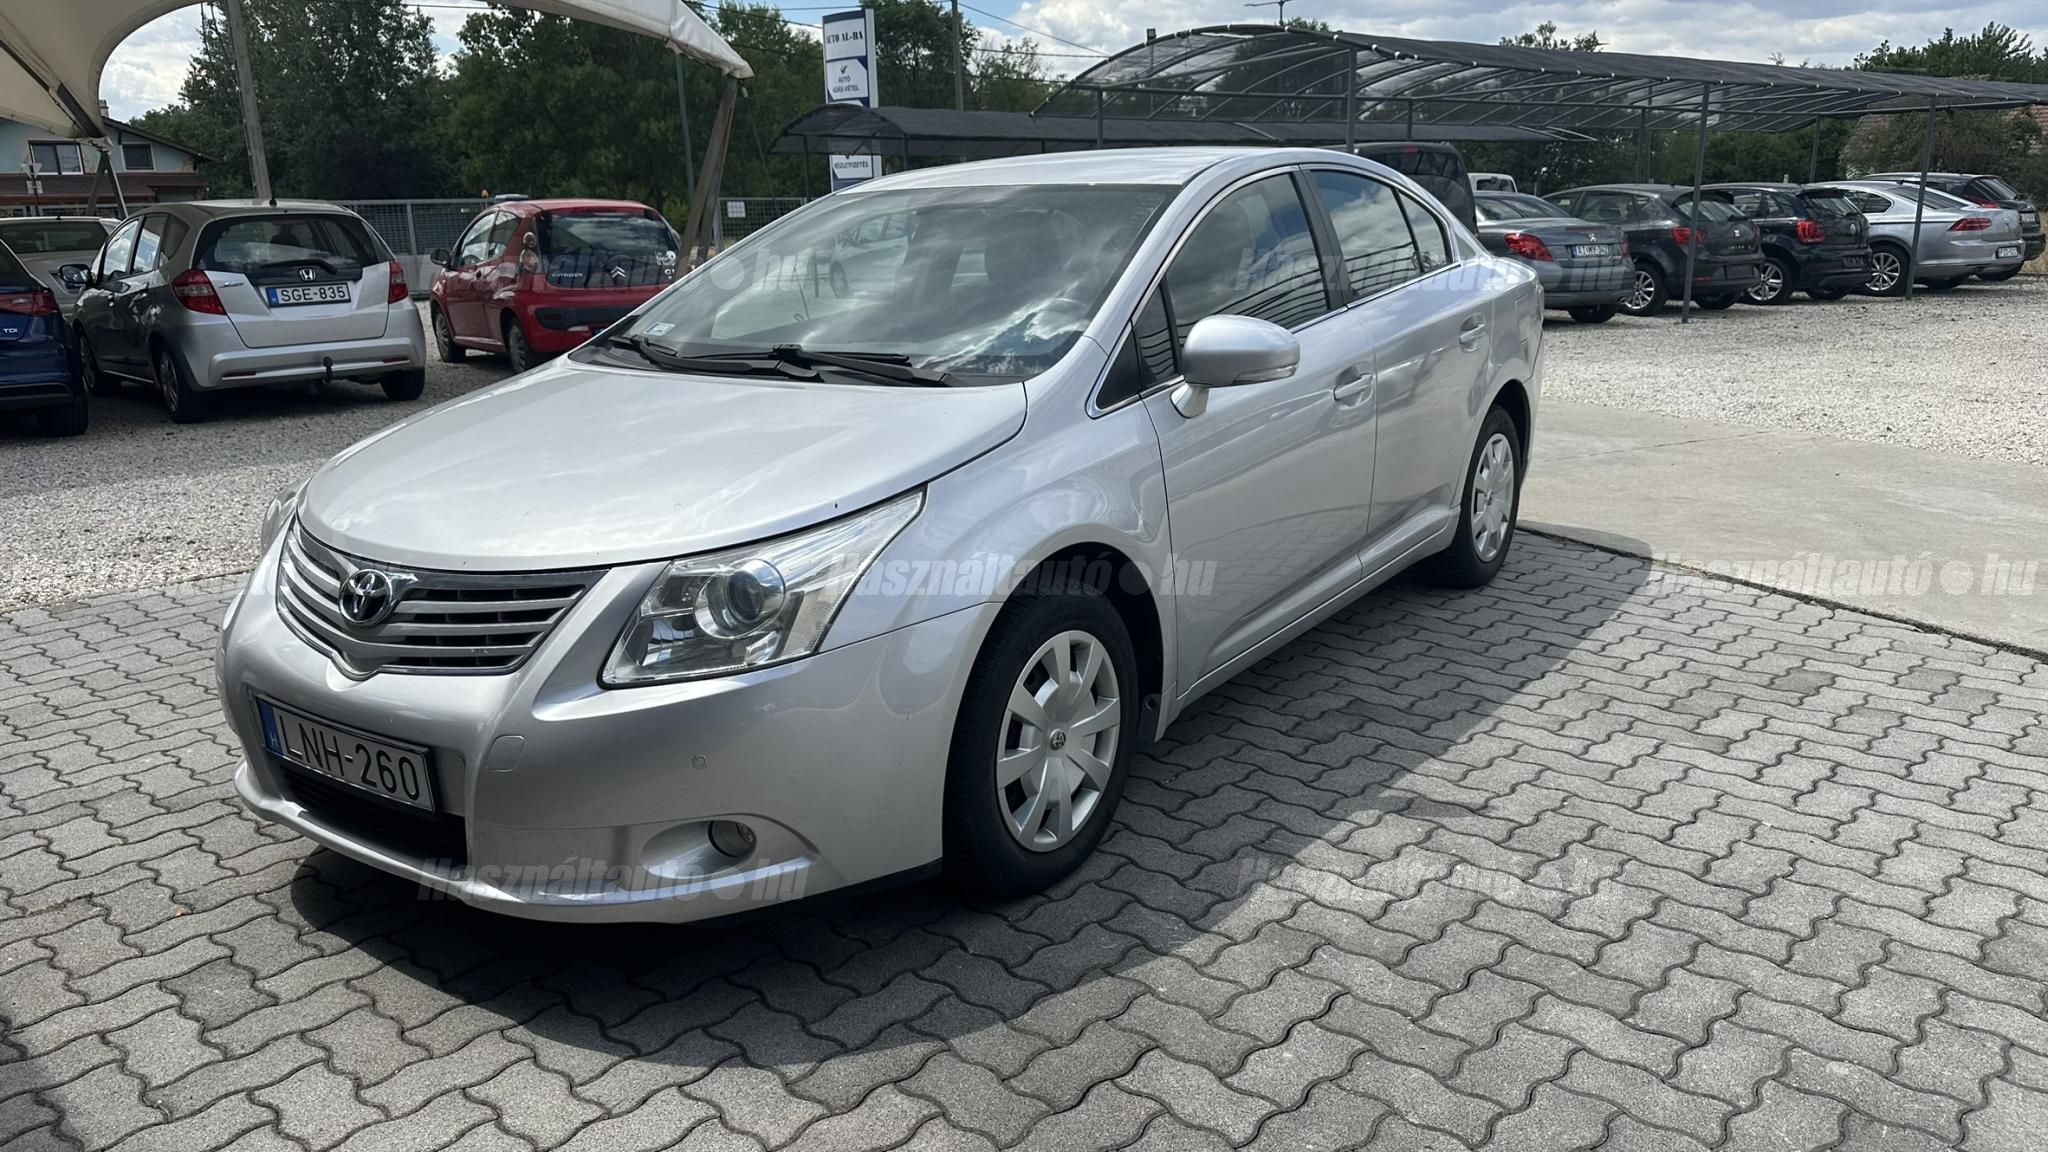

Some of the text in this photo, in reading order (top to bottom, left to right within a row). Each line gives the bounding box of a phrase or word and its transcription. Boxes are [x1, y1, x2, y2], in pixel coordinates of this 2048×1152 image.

[280, 286, 346, 302] SGE-835
[271, 733, 278, 745] H
[279, 715, 420, 801] LNH-260
